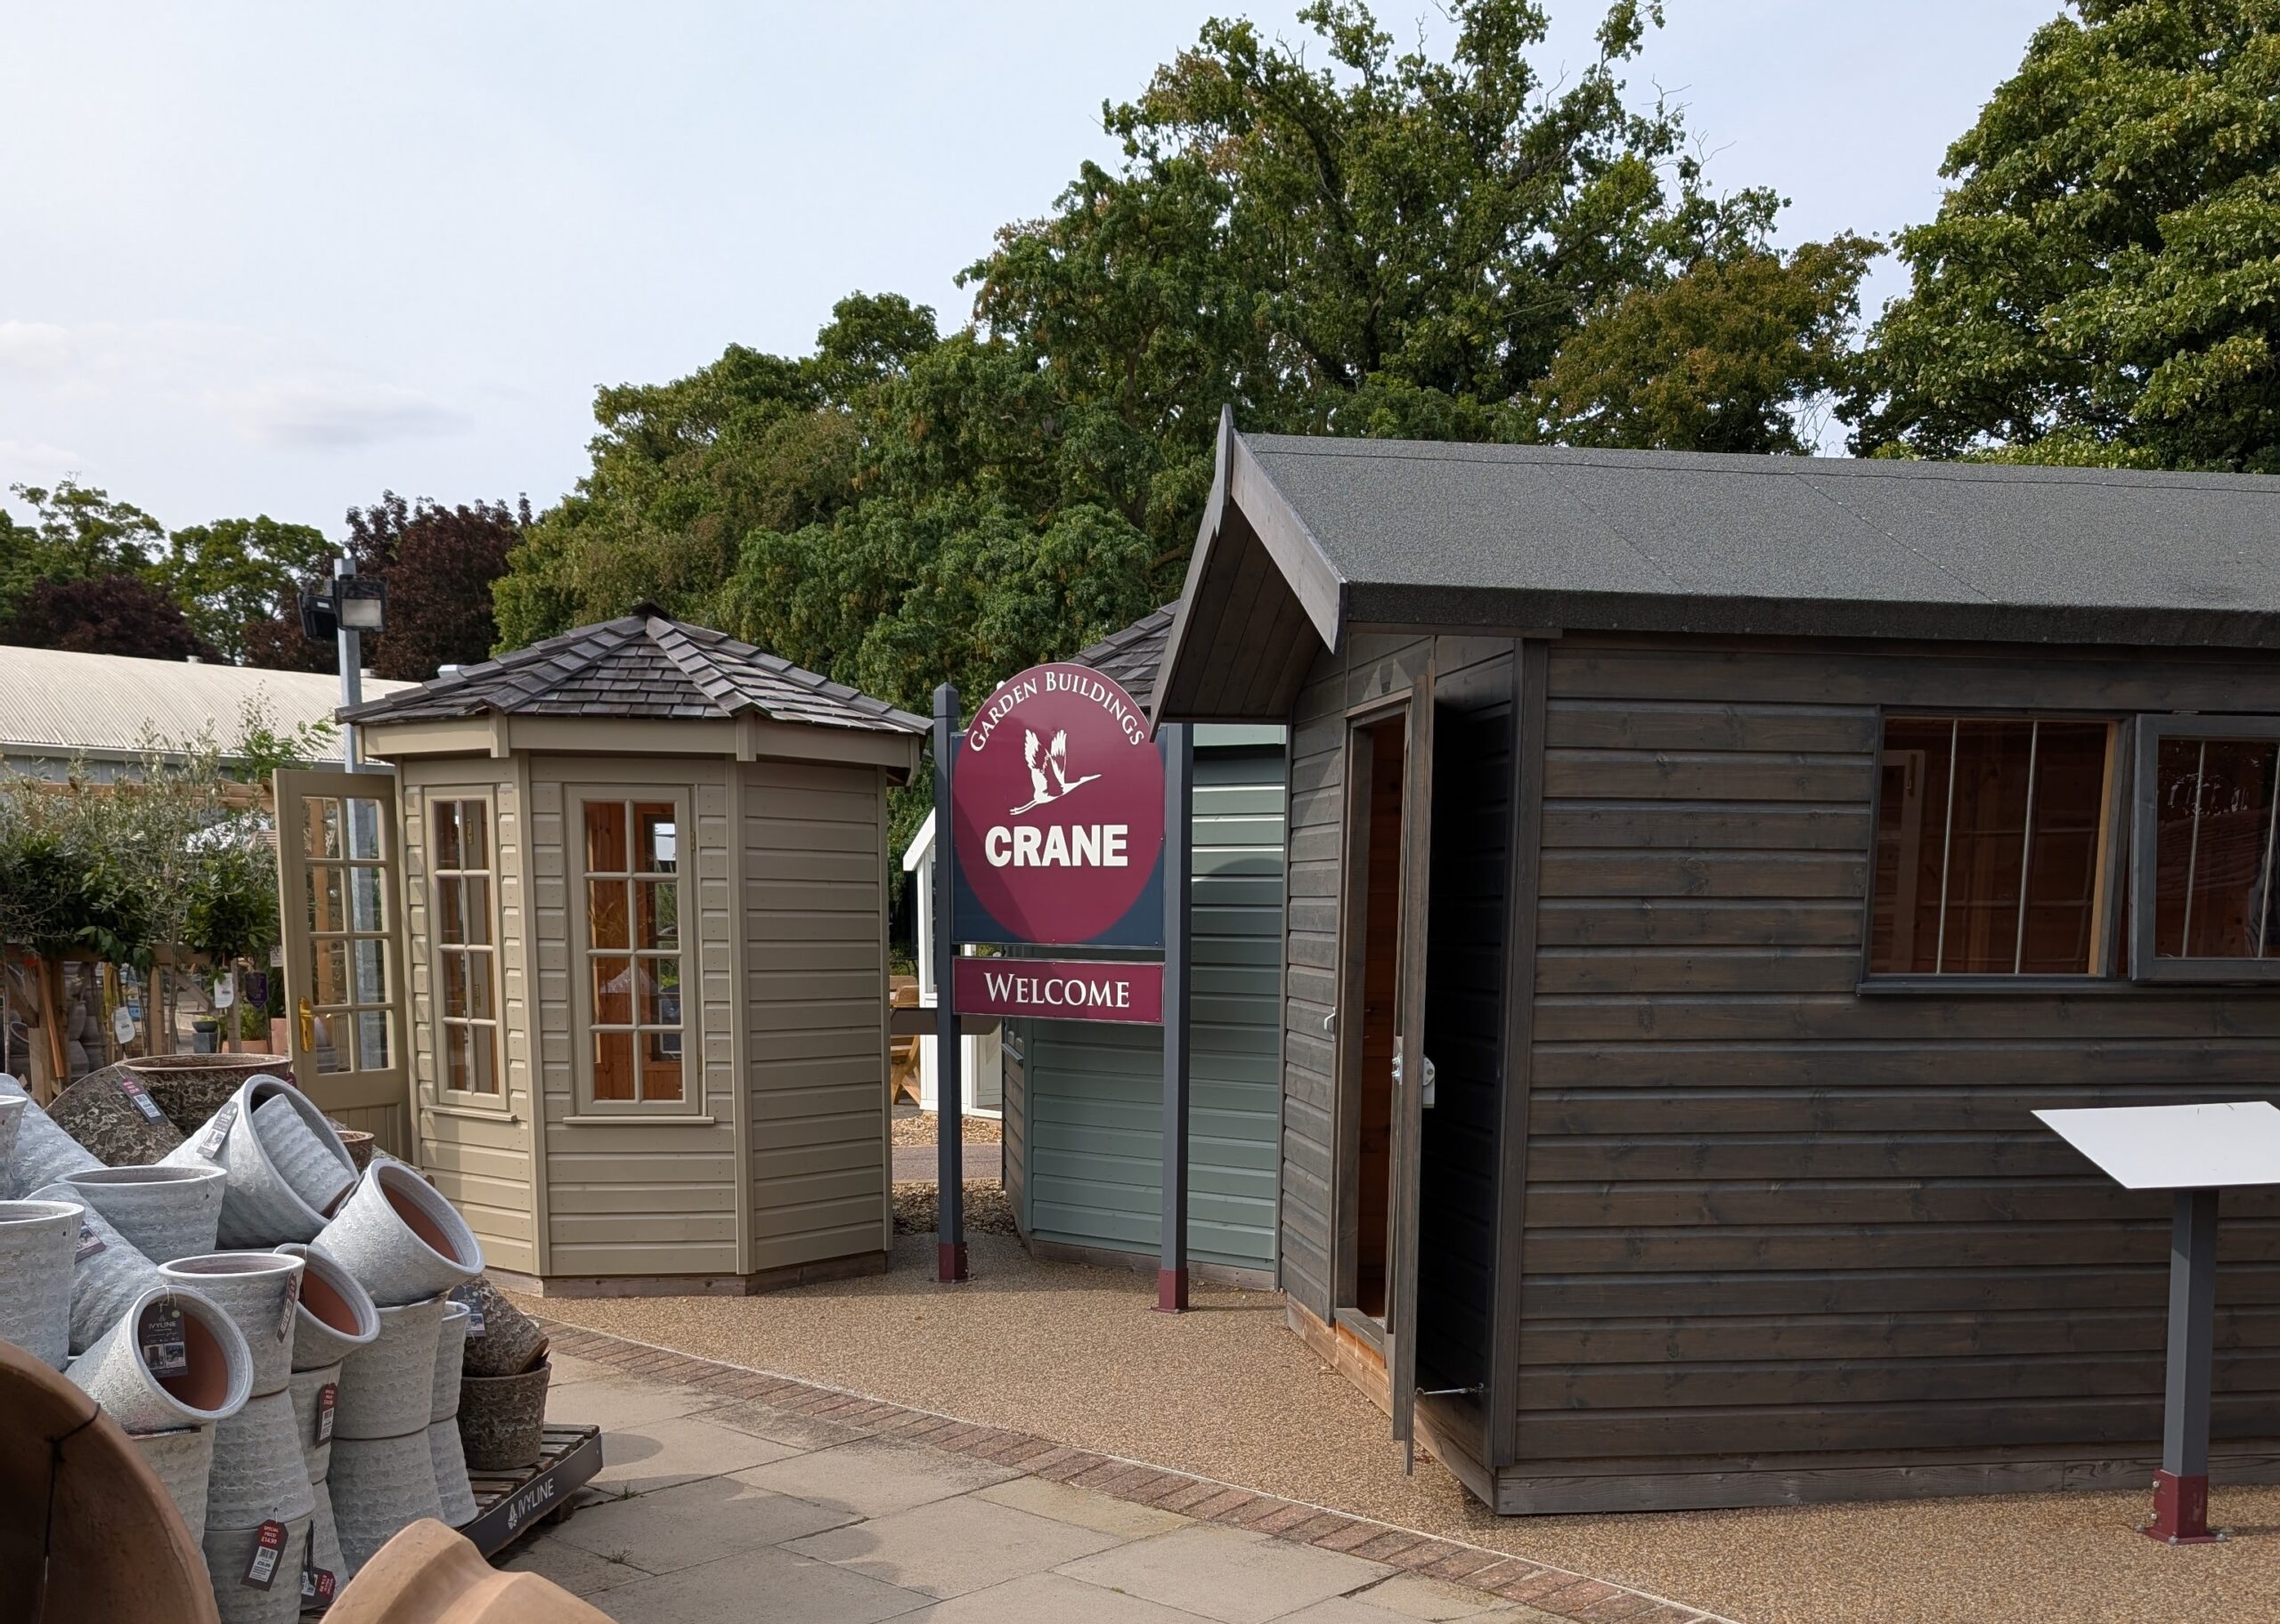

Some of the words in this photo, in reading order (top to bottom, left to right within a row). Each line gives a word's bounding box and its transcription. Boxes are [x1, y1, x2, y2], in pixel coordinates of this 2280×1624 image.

[970, 677, 1038, 752] GARDEN
[1045, 671, 1145, 746] BUILDINGS
[984, 824, 1128, 867] CRANE
[983, 972, 1131, 1008] WELCOME
[149, 1320, 177, 1329] IVYLINE
[517, 1477, 555, 1519] IVYLINE
